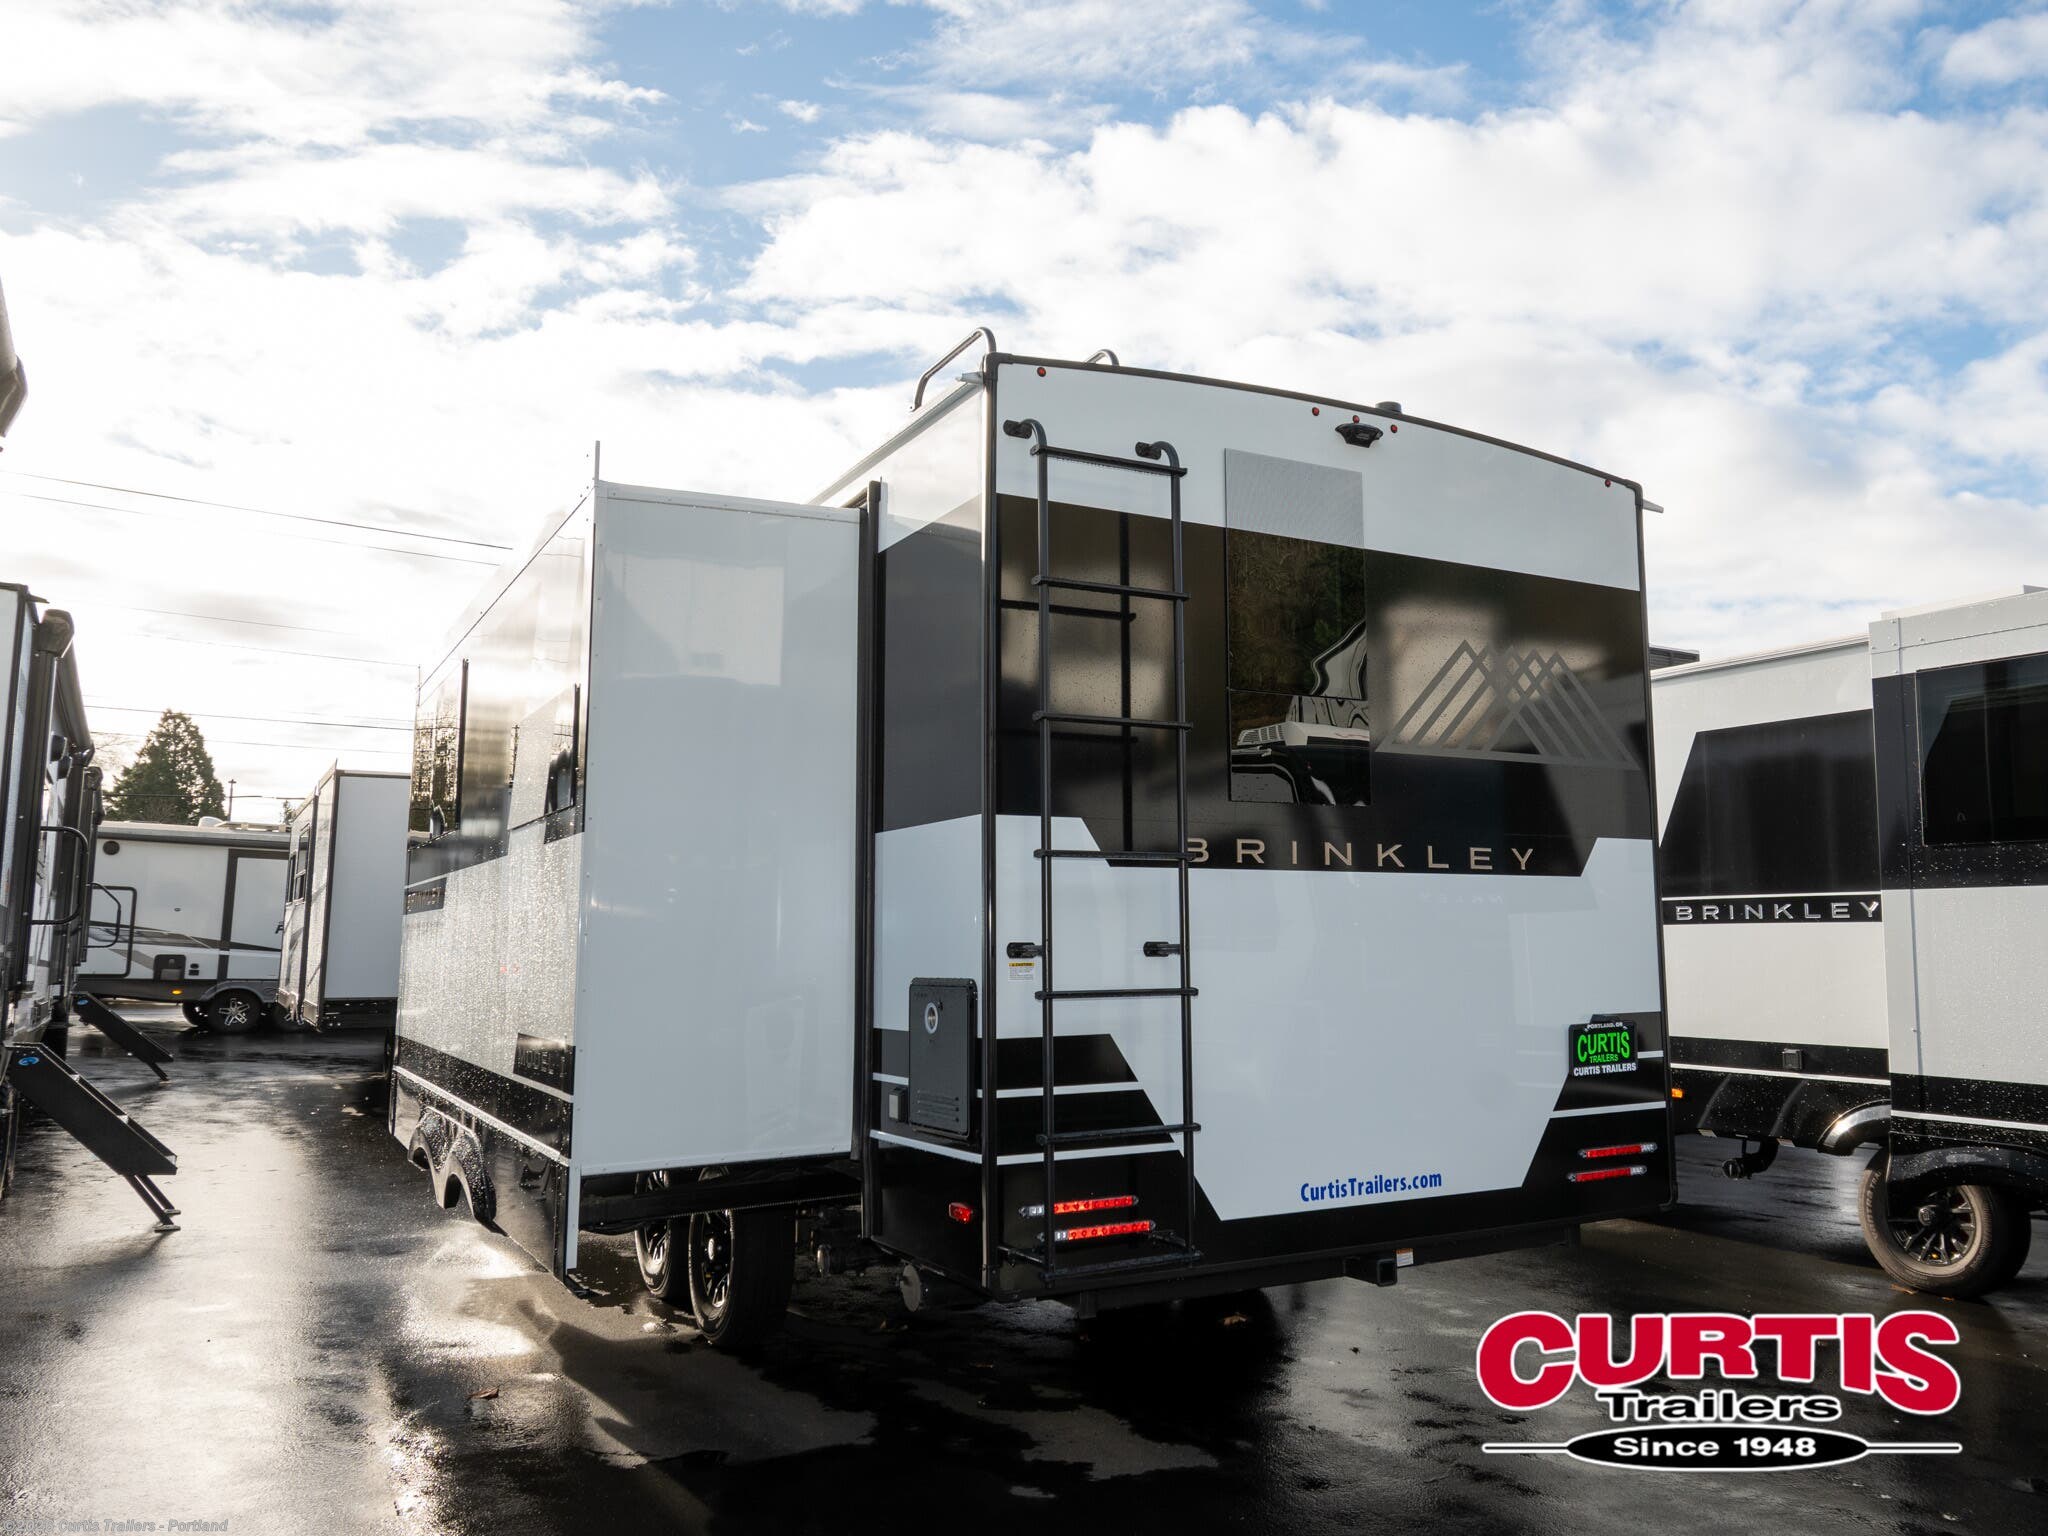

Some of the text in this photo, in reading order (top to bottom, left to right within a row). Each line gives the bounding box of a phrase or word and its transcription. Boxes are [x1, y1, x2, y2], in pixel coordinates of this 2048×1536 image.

[1186, 837, 1534, 870] BRINKLEY
[1675, 902, 1879, 921] BRINKLEY
[1577, 1031, 1631, 1062] CURTIS
[1589, 1053, 1619, 1063] TRAILERS
[1573, 1062, 1637, 1076] CURTIS TRAILERS
[1301, 1173, 1442, 1202] CurtisTrailers.com
